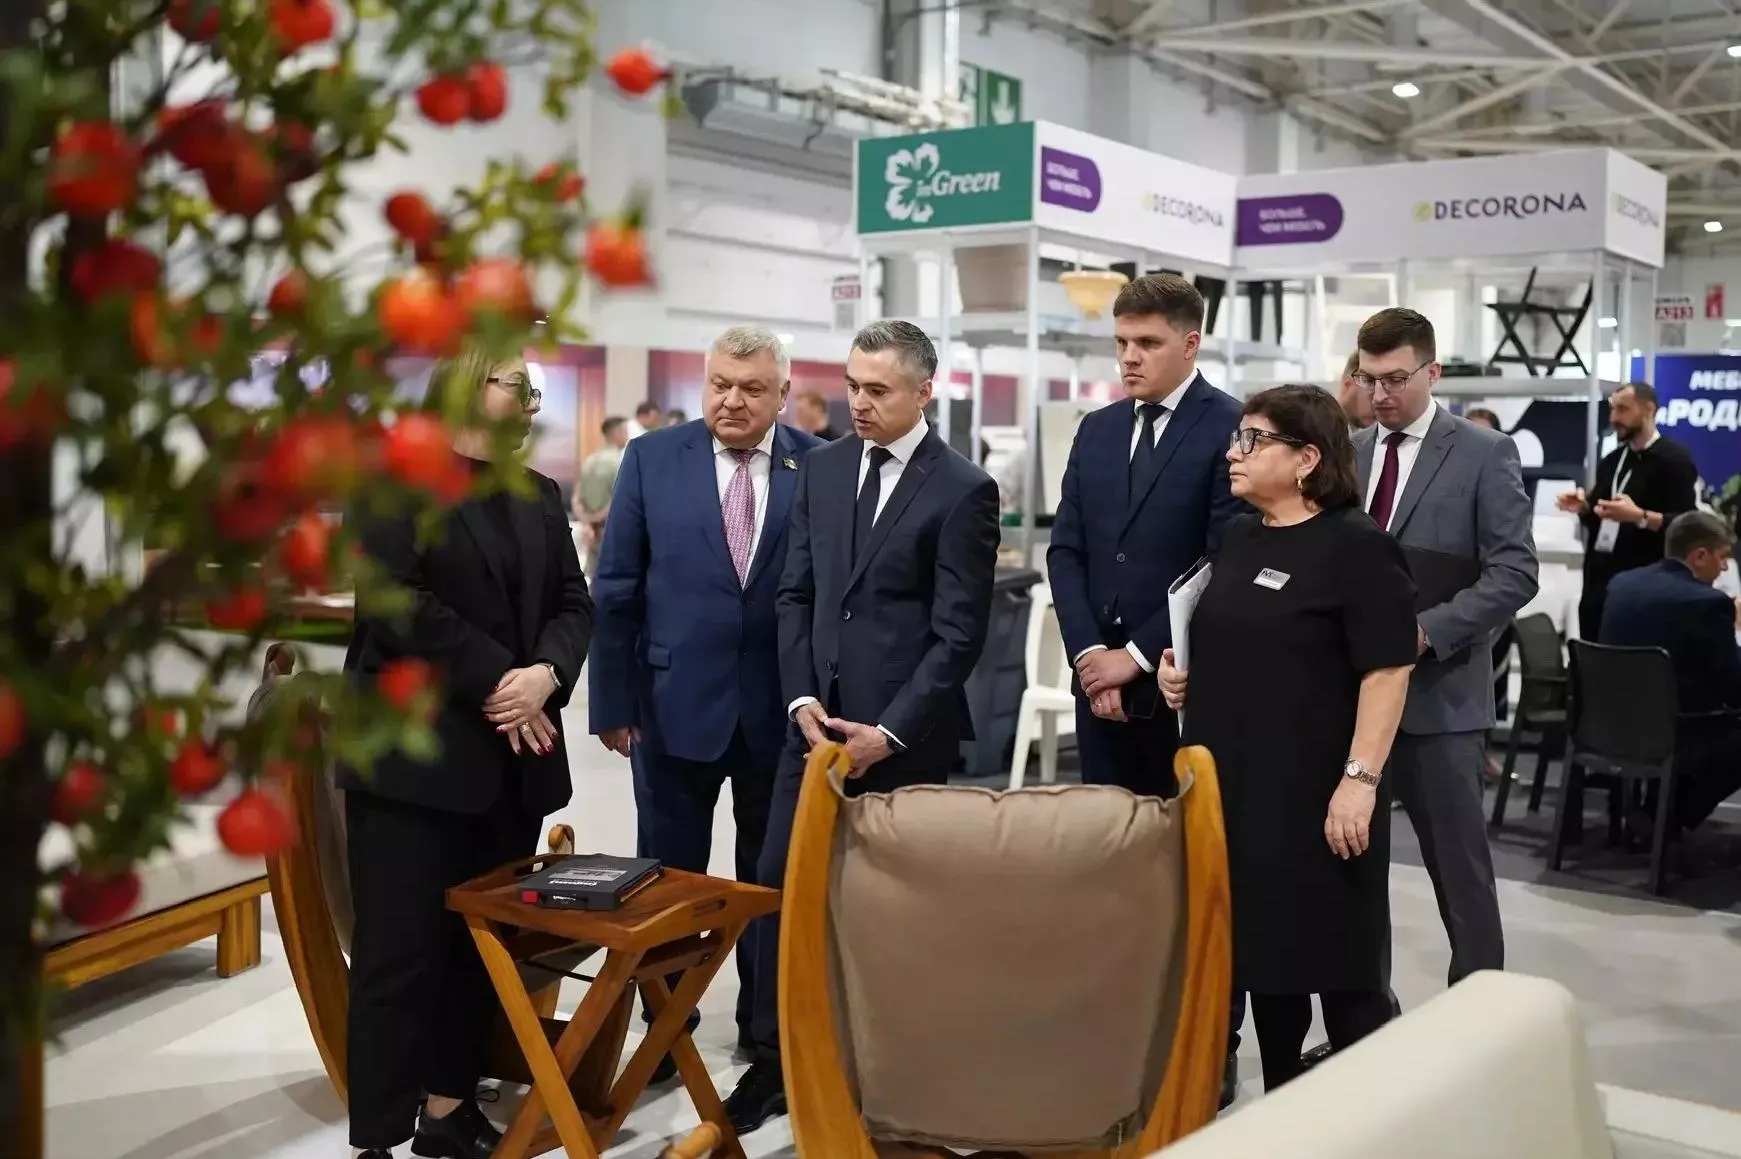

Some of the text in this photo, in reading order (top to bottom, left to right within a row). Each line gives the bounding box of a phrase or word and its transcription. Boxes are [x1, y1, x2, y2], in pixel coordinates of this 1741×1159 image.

[1152, 193, 1225, 229] DECORONA
[1434, 192, 1587, 221] DECORONA
[1689, 370, 1741, 391] МЕБ
